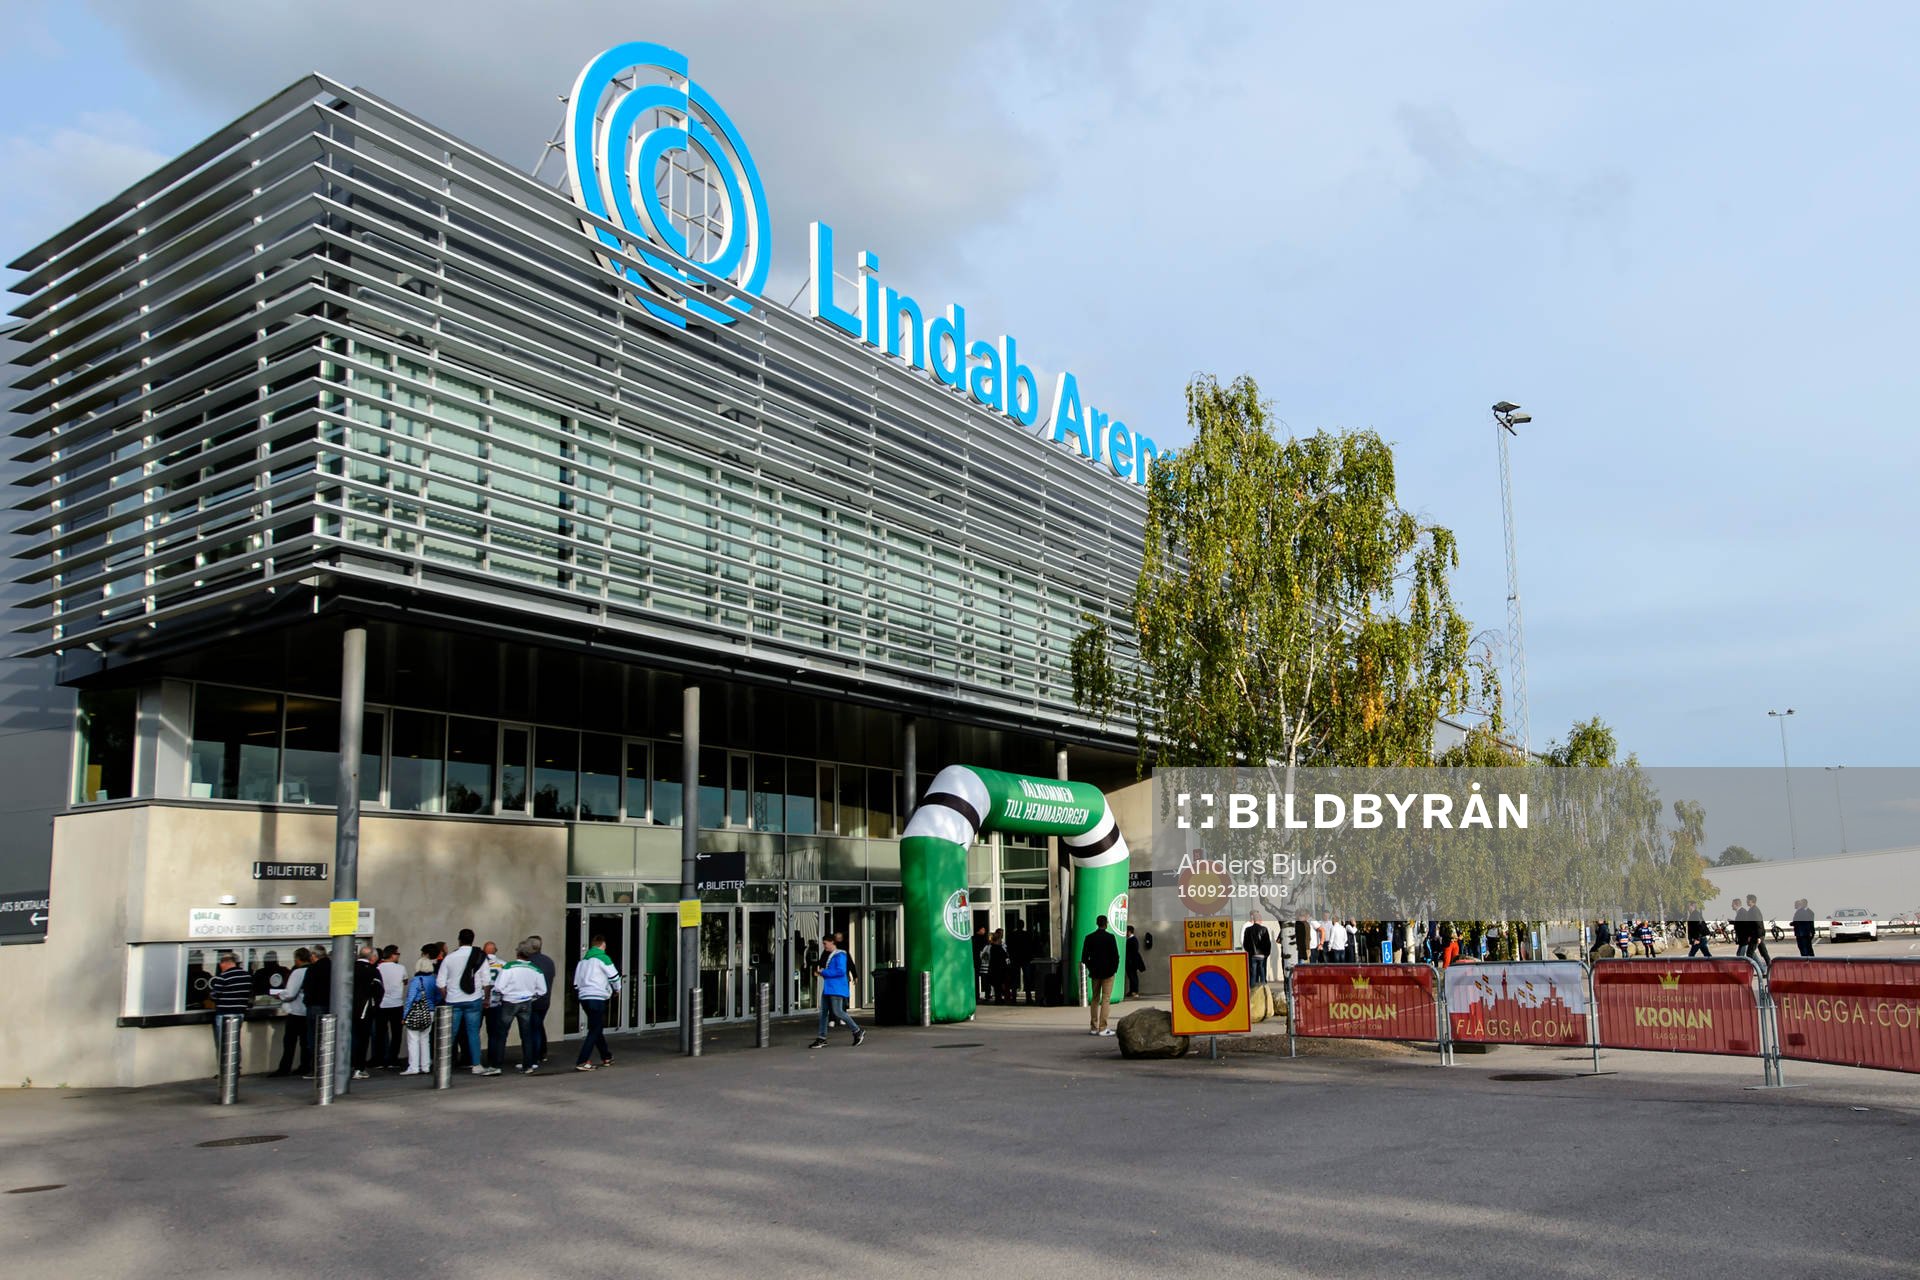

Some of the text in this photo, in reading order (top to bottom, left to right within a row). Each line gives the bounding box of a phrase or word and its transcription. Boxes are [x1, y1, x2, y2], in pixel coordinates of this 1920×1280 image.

[810, 220, 1176, 485] Lindab Aren
[1018, 778, 1075, 803] VÄLKOMMEN
[1004, 799, 1090, 825] TILL HEMMABORGEN
[266, 865, 317, 877] BILJETTER
[706, 880, 745, 890] BILJETTER
[1187, 920, 1229, 930] Gäller ej
[1189, 929, 1227, 939] behörig
[1194, 939, 1222, 948] trafik
[1329, 1002, 1398, 1021] KRONAN
[1635, 1006, 1713, 1029] KRONAN
[1456, 1019, 1573, 1039] FLAGGA.COM
